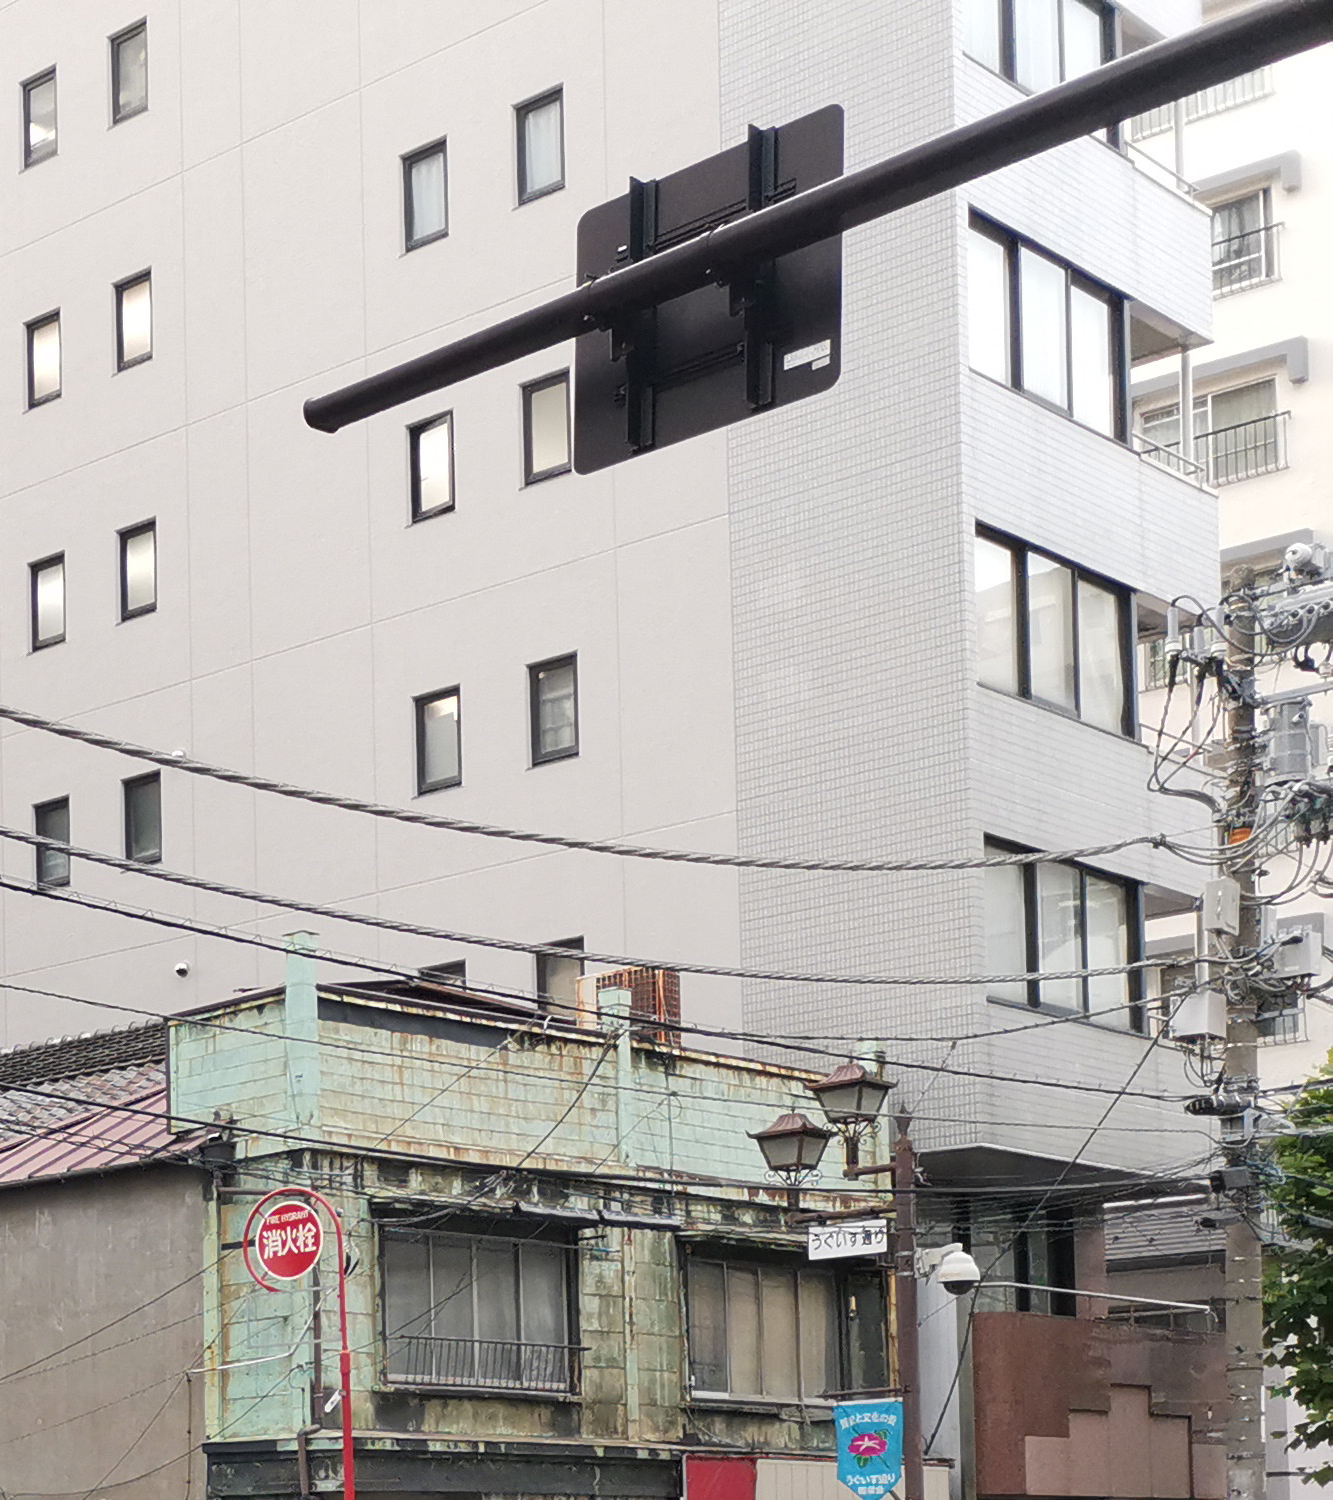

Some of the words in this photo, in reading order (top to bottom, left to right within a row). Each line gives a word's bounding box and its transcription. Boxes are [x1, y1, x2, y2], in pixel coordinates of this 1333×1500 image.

[262, 1222, 317, 1260] 消火栓
[811, 1226, 886, 1251] うぐいす通り
